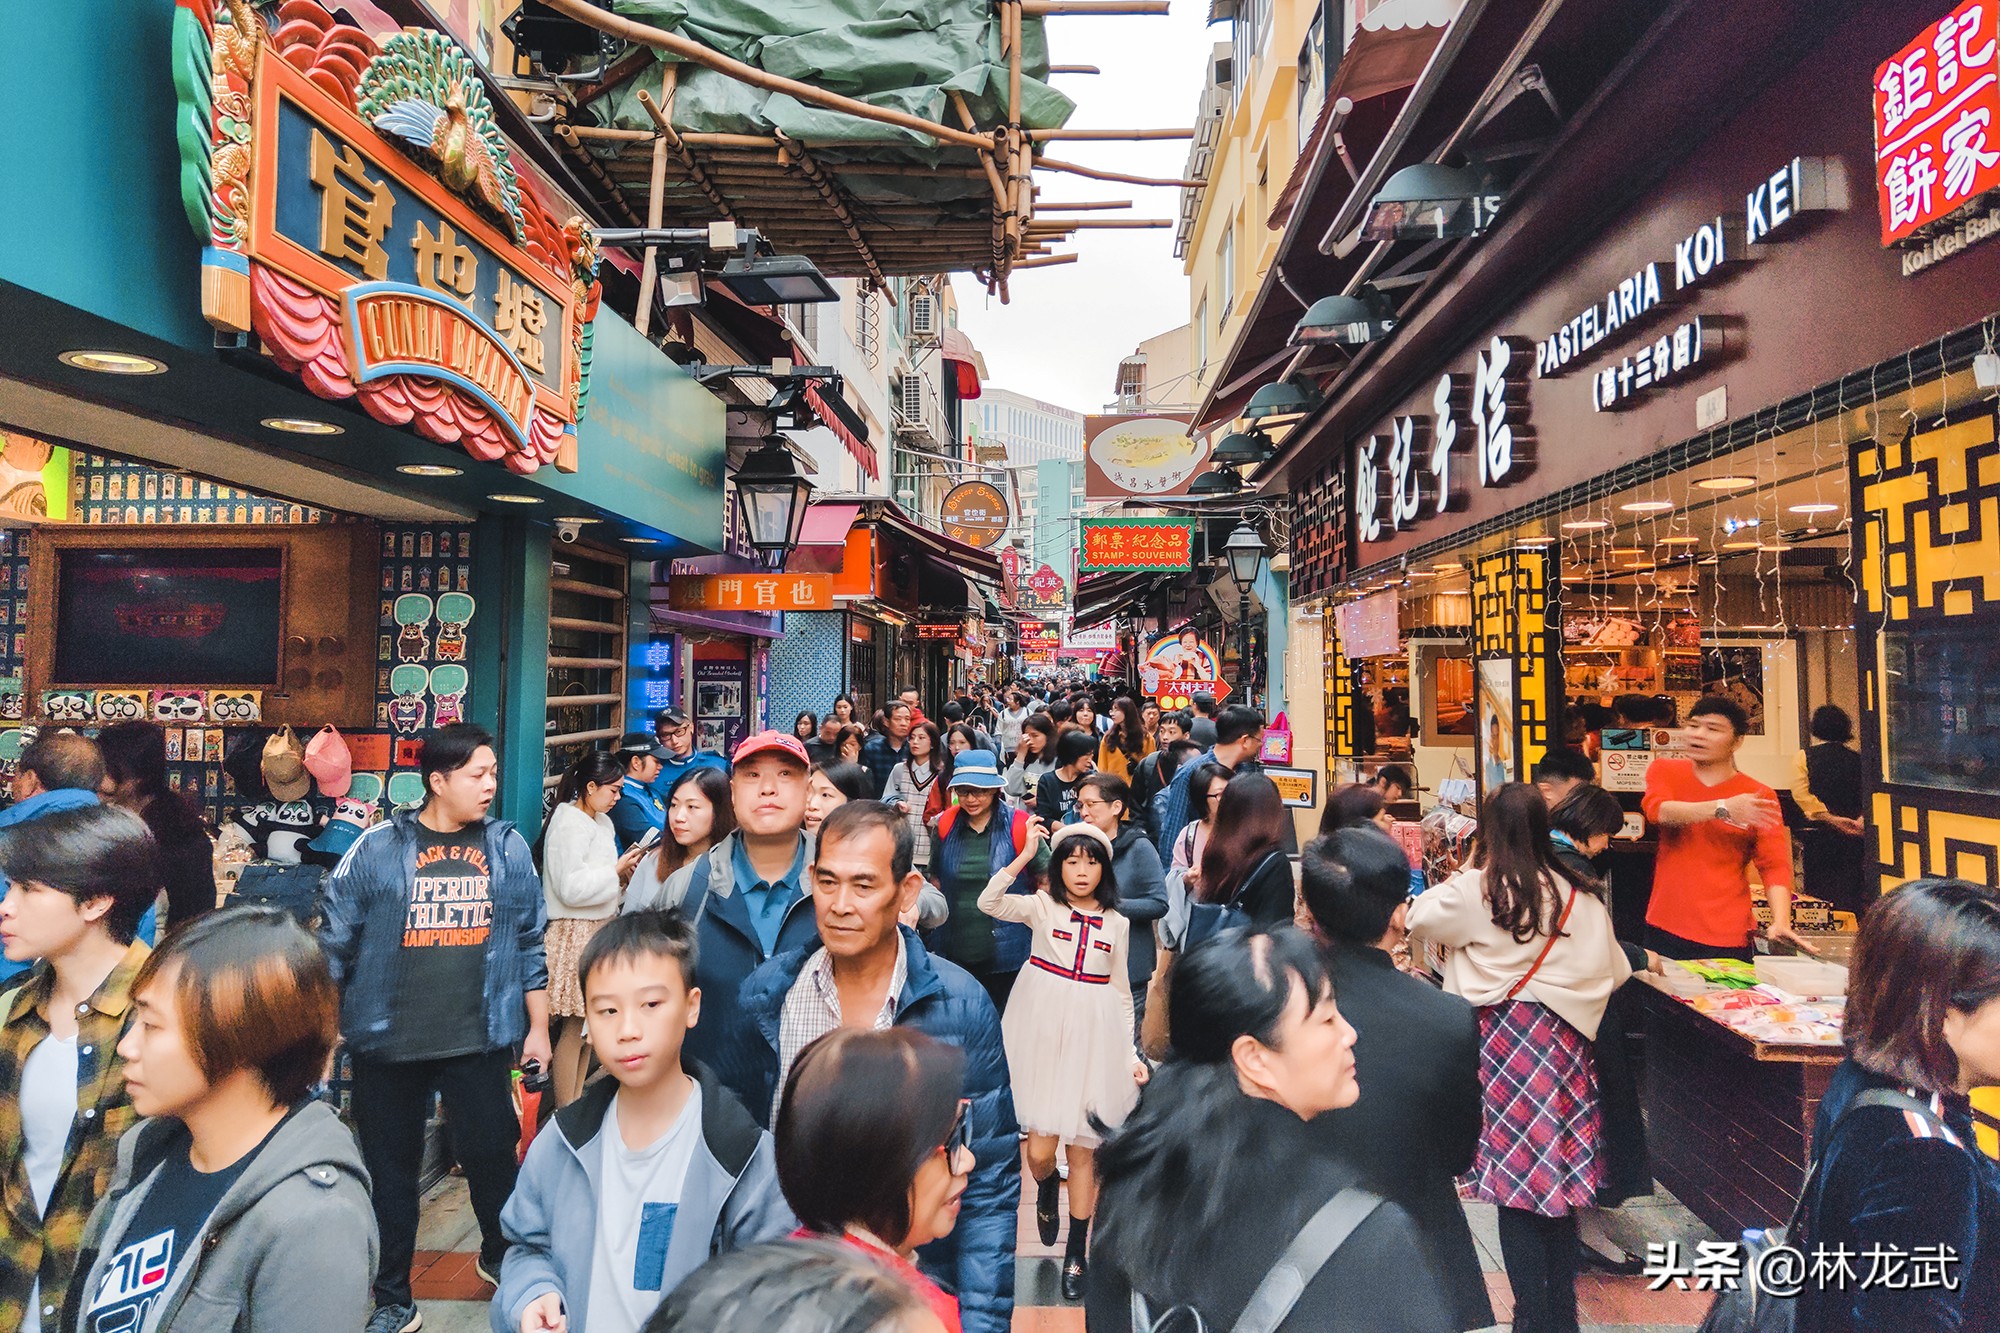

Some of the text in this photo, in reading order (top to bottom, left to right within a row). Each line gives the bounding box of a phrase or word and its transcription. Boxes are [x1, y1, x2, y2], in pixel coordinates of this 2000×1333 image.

[1879, 5, 1996, 137] 鉅記
[1883, 108, 2000, 233] 餅家
[1536, 156, 1800, 379] PASTELARIA KOI KEI
[1902, 247, 1934, 277] Koi
[1932, 227, 1967, 263] Kei
[366, 301, 443, 364] CUNHA
[451, 316, 525, 423] BAZAAR
[1092, 532, 1183, 550] 郵票·紀念品
[1092, 551, 1183, 560] STAMP SOUVENIR
[450, 845, 461, 860] &
[411, 875, 491, 902] PERDR
